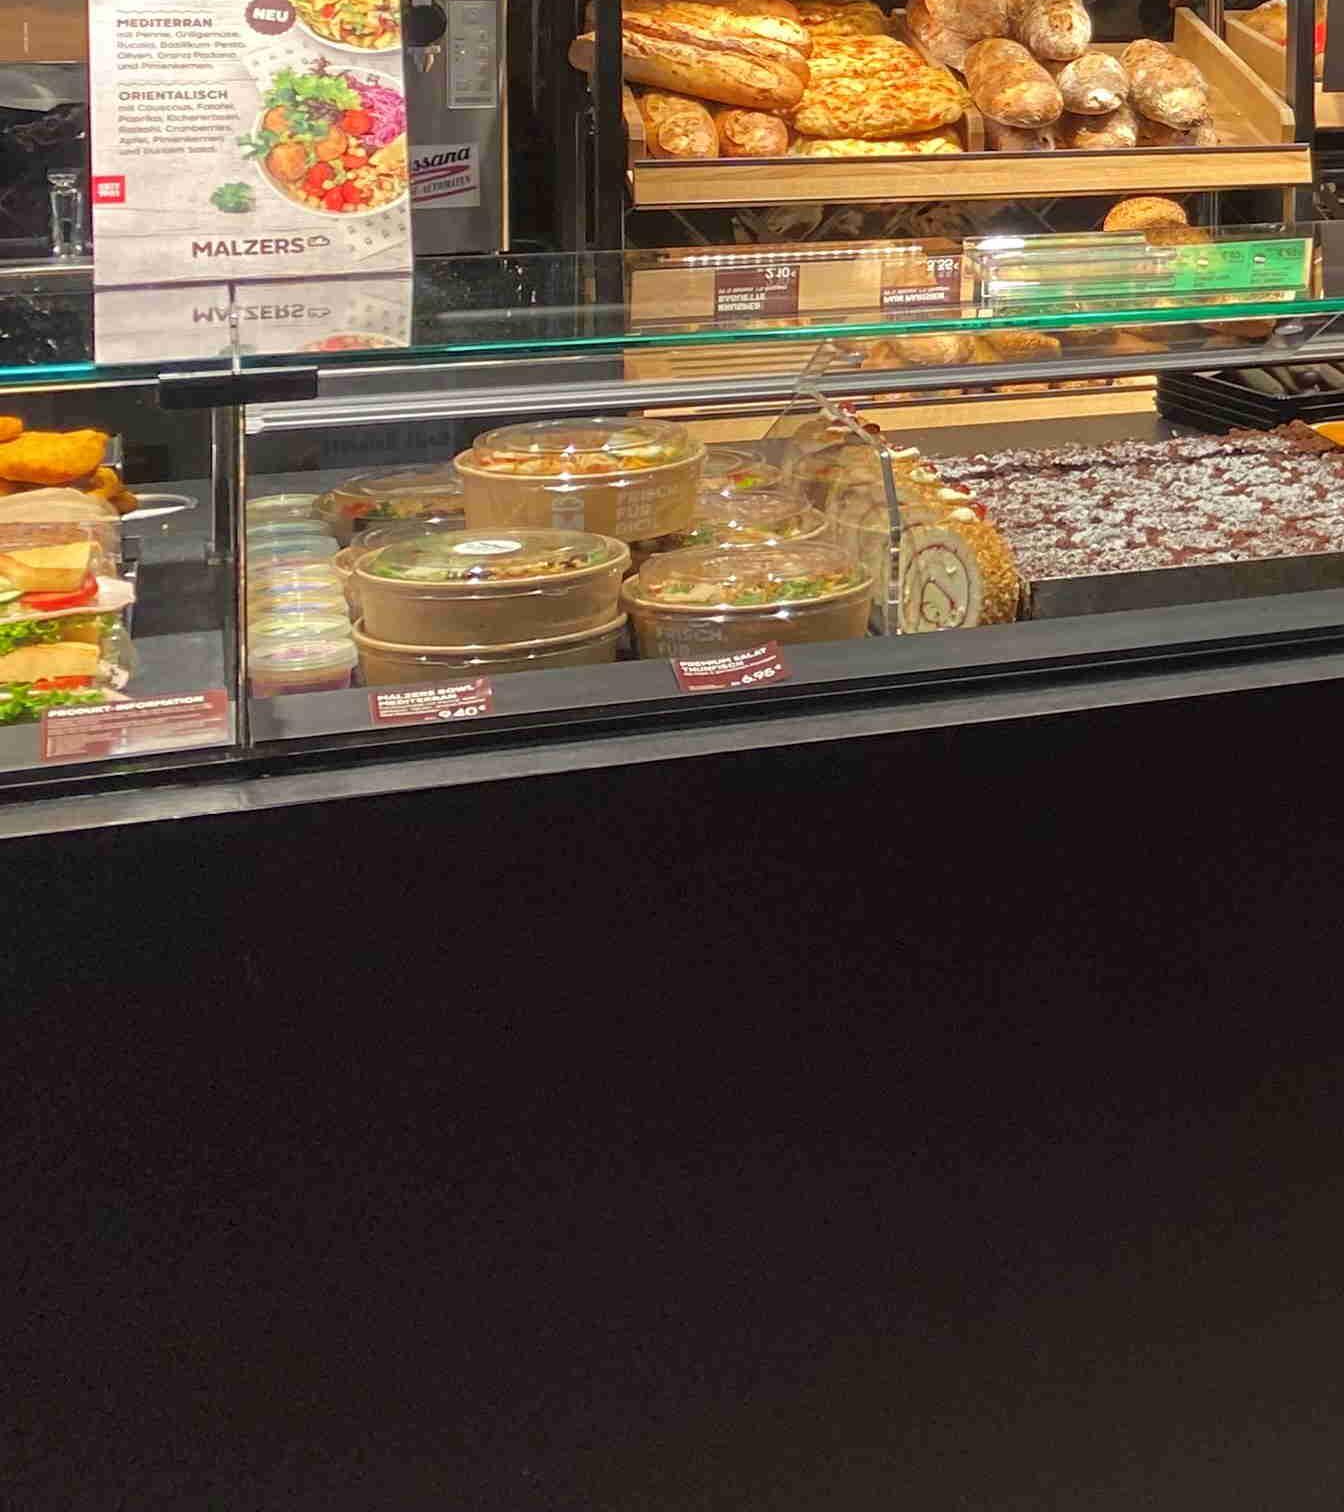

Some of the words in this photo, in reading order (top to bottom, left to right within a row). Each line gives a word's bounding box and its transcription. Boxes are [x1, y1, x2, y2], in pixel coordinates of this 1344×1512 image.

[252, 7, 289, 23] NEU
[116, 18, 213, 28] MEDITERRAN
[118, 90, 228, 101] ORIENTALISCH
[191, 237, 305, 258] MALZERS
